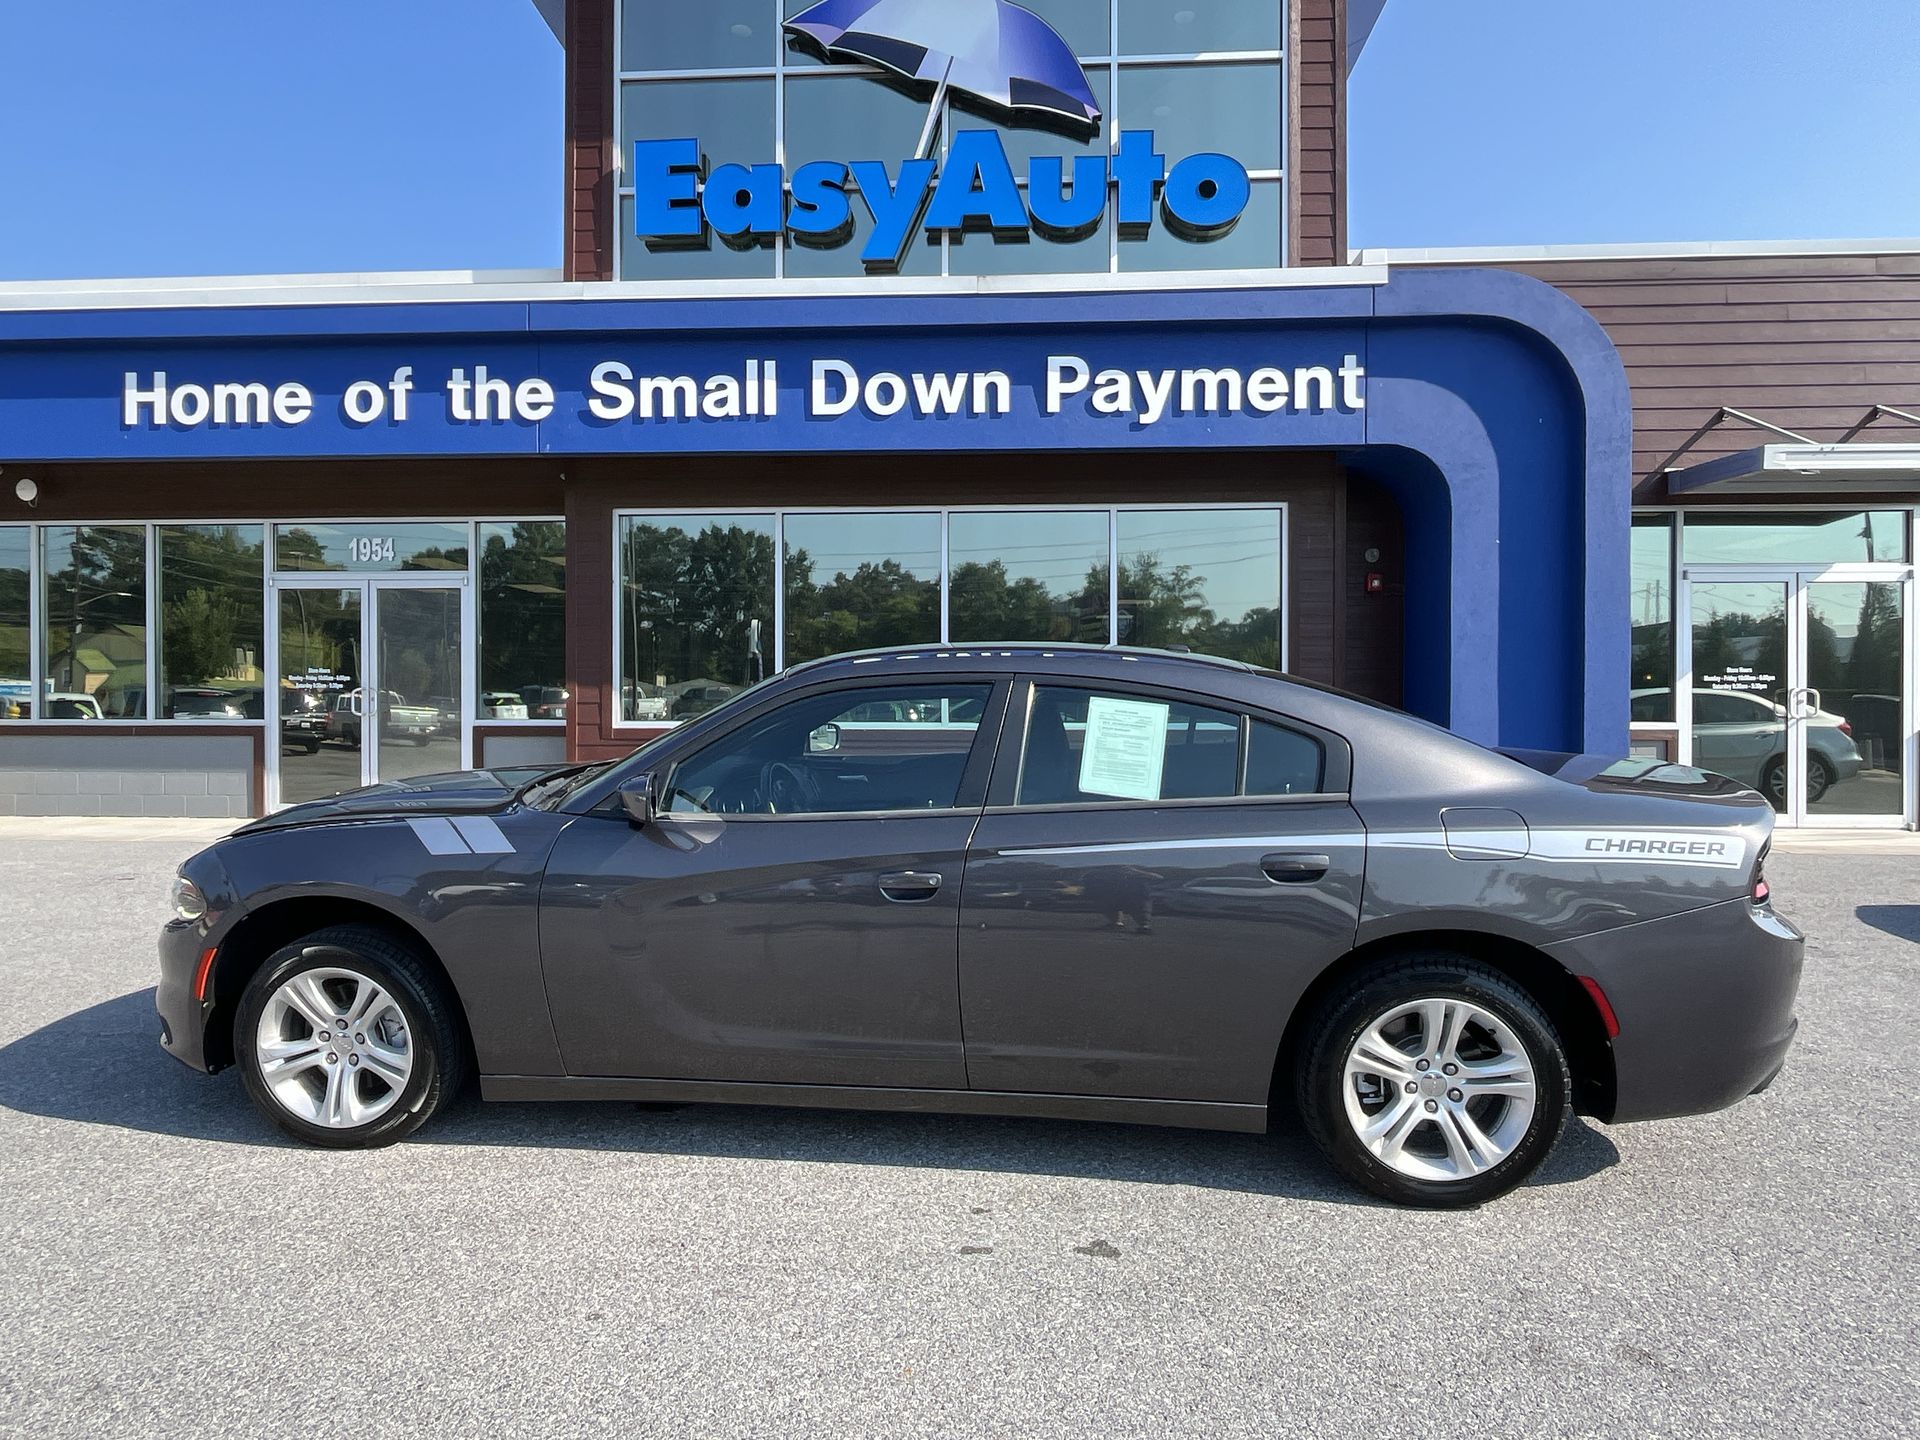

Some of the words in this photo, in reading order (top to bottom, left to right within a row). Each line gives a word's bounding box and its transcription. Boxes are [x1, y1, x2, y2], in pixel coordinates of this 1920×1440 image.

[634, 128, 1251, 268] EasyAuto
[123, 370, 313, 426] Home
[342, 366, 414, 423] of
[446, 365, 555, 422] the
[587, 358, 777, 420] Small
[811, 359, 1011, 416] Down
[1045, 353, 1366, 425] Payment
[348, 536, 395, 562] 1954
[1584, 837, 1727, 856] CHARGER
